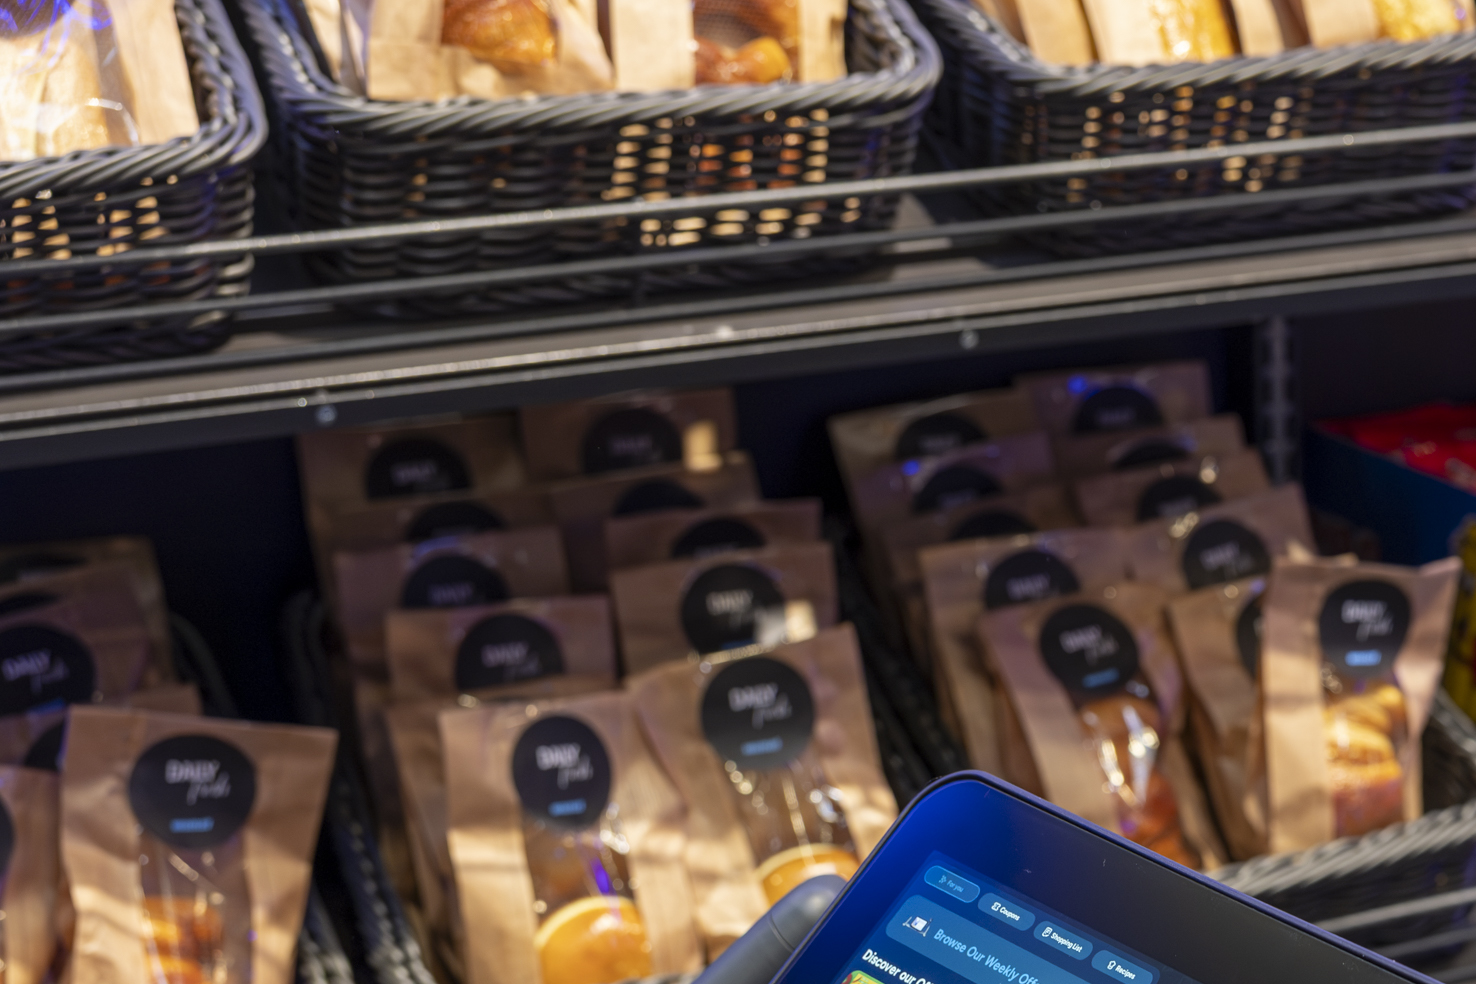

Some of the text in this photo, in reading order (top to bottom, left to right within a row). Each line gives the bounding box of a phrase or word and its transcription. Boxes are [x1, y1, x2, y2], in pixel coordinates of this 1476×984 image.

[999, 906, 1020, 922] Coupons
[1050, 931, 1083, 953] Shopping List
[862, 948, 901, 977] Discover
[933, 929, 967, 953] Browse
[966, 946, 985, 962] Our
[985, 955, 1019, 982] Weekly
[1115, 964, 1136, 981] Recipes
